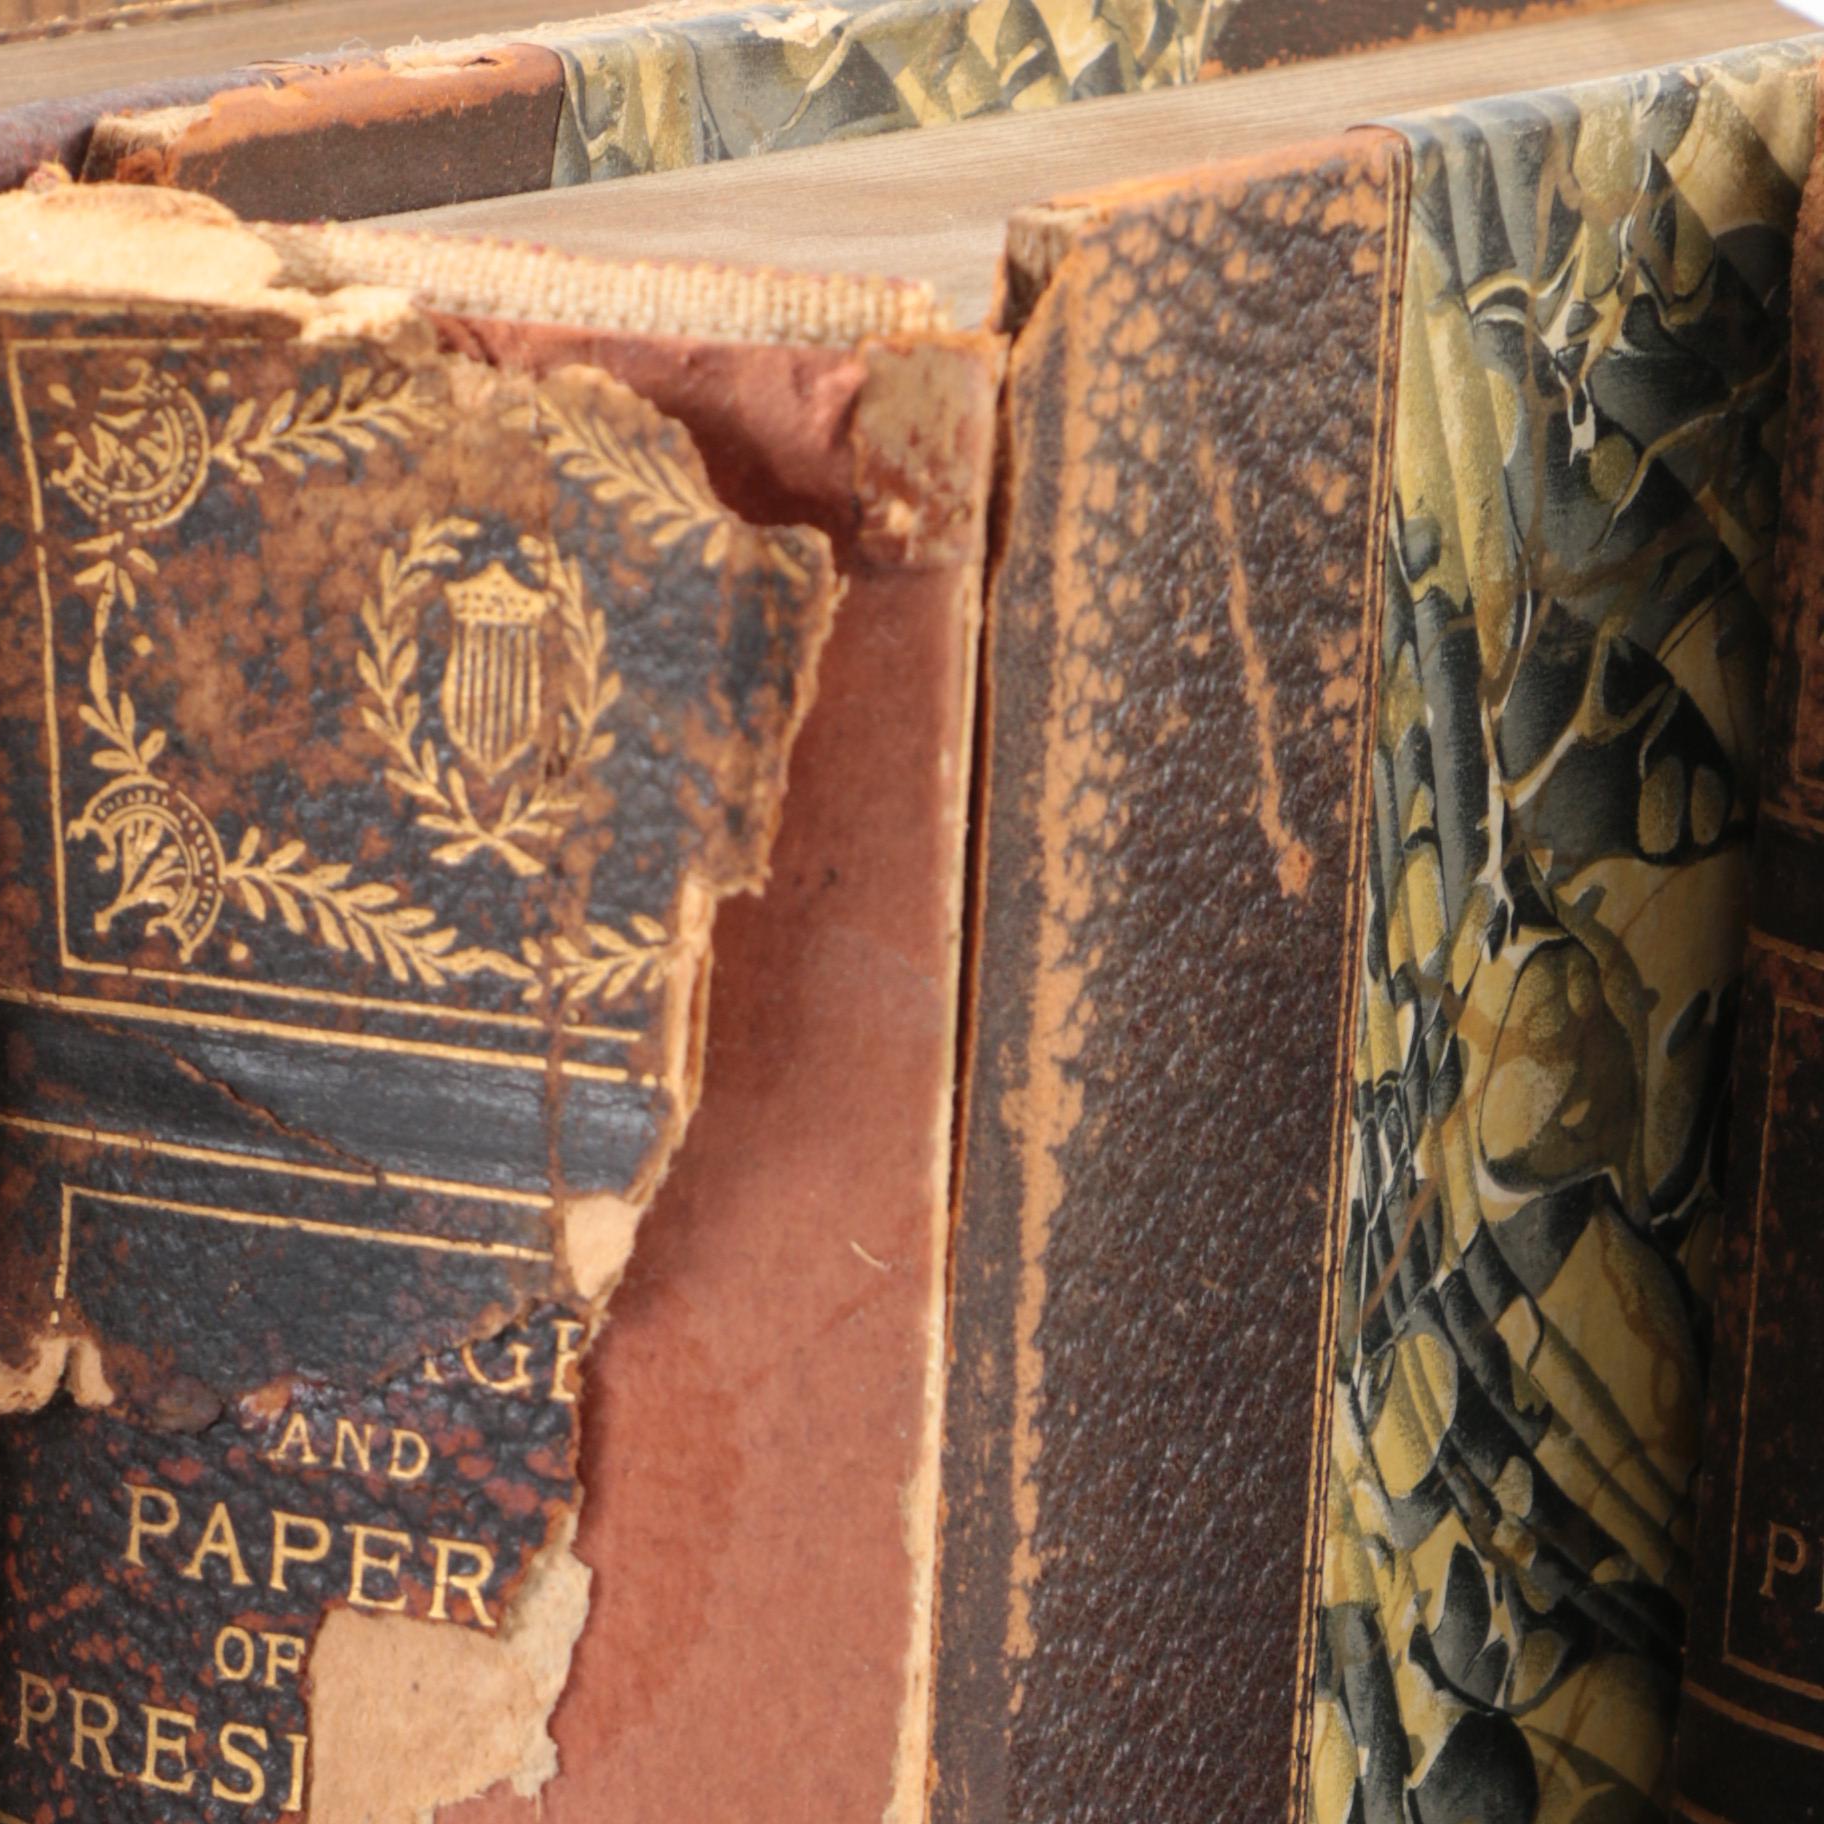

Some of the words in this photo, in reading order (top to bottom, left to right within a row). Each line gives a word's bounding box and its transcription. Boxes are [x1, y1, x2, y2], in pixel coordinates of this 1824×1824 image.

[266, 1412, 431, 1481] AND
[121, 1482, 498, 1629] PAPER
[1758, 1520, 1824, 1614] P
[213, 1625, 307, 1689] OF
[14, 1671, 309, 1812] PRESI
